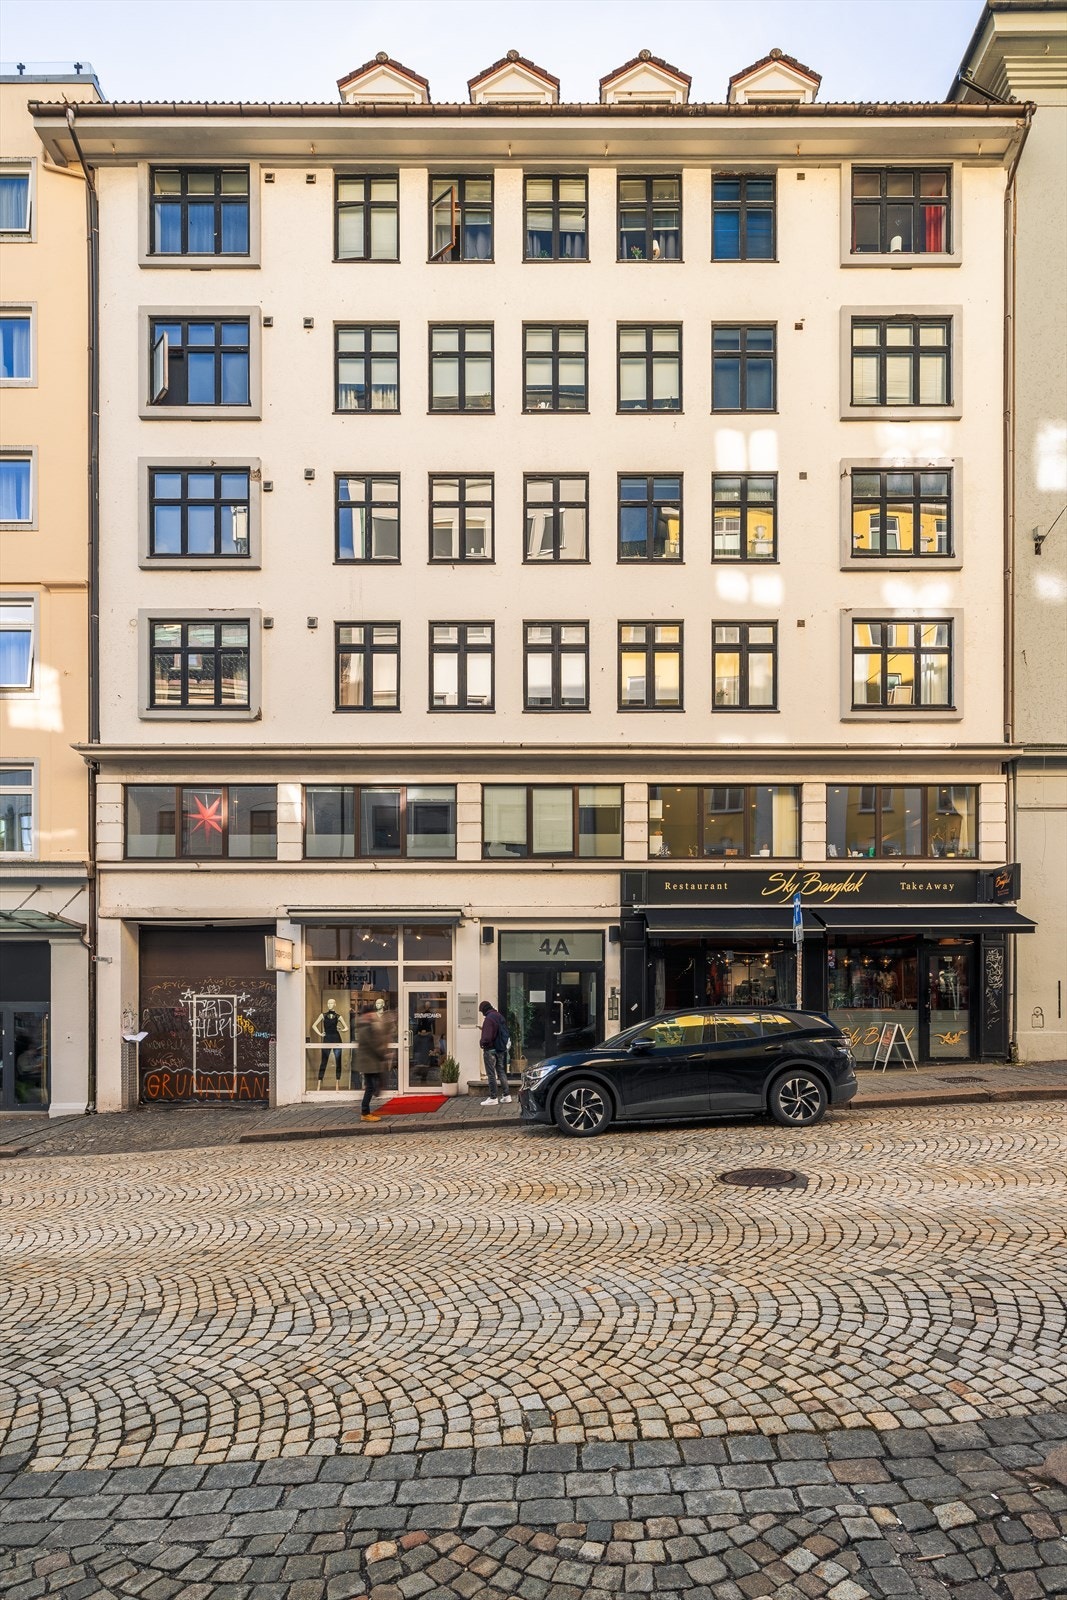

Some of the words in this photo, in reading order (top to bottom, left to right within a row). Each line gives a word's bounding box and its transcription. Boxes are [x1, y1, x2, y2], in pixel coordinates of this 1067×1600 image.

[664, 881, 728, 890] Restaurant
[761, 872, 800, 903] Sky
[800, 872, 867, 903] Bangkok
[538, 938, 570, 955] 4A
